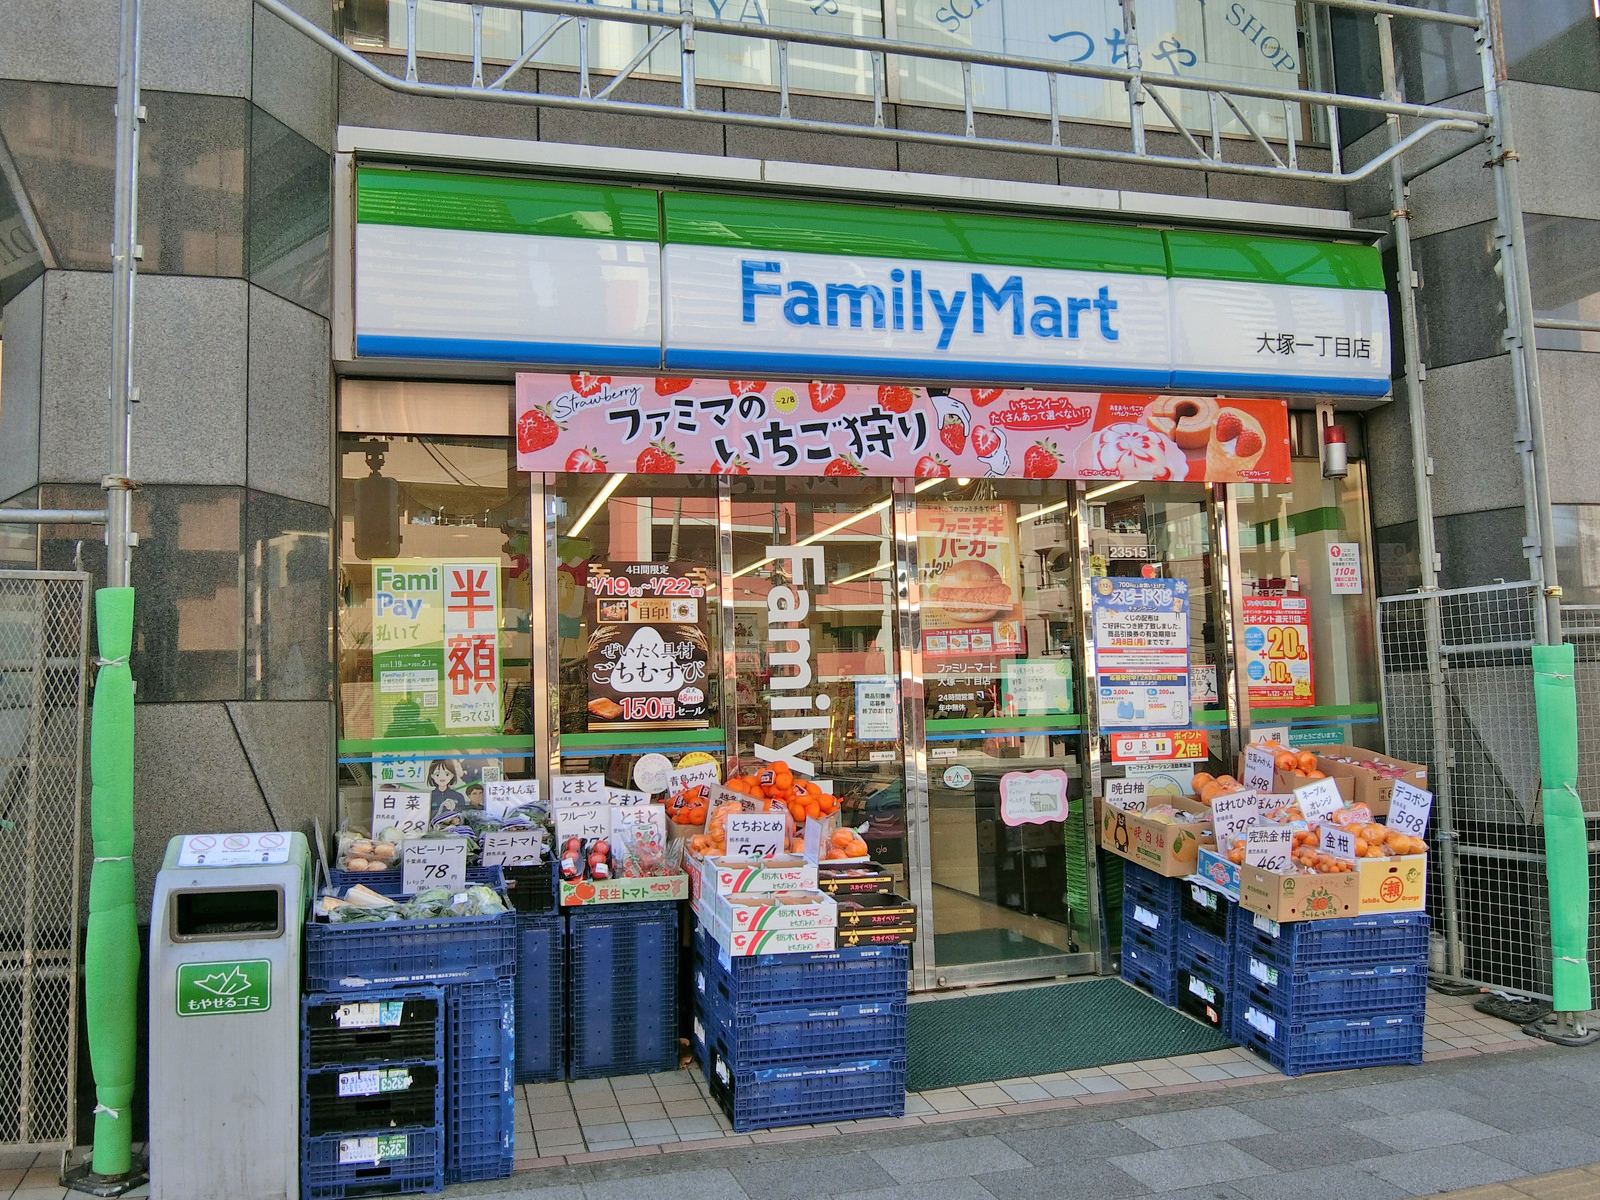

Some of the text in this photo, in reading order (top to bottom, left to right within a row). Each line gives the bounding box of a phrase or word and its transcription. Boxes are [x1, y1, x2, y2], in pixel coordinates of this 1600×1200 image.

[1225, 2, 1296, 73] SHOP
[741, 260, 1119, 350] FamilyMart
[1256, 332, 1372, 358] 大塚一丁目店
[554, 384, 643, 419] Strawberry
[609, 394, 767, 442] ファミマの
[714, 407, 928, 468] いちご狩り
[929, 516, 1004, 538] ファミチキ
[938, 538, 998, 559] バーガー
[1109, 547, 1147, 558] 23515
[625, 564, 670, 576] 4日間限定
[376, 567, 438, 591] Fami
[1110, 589, 1172, 606] スピードくじ
[376, 593, 423, 620] Pay
[639, 607, 670, 620] 目印!
[376, 623, 421, 642] 払いで
[447, 568, 497, 695] 半額
[1102, 622, 1182, 630] ご好評につき終了致しました。
[601, 641, 695, 660] ぜいたく具材
[592, 660, 706, 685] ごちむすび
[937, 663, 998, 673] ファミリーマート
[937, 677, 992, 687] 大塚一丁目店
[938, 693, 975, 702] 24時間営業
[619, 697, 676, 720] 150円
[675, 706, 706, 717] セール
[938, 704, 967, 712] 年中無休
[450, 710, 496, 723] 戻ってくる!
[1174, 731, 1202, 740] ポイント
[1258, 731, 1282, 743] 八朔
[1174, 739, 1203, 759] 2倍!
[1247, 751, 1274, 769] 甘夏みかん
[381, 767, 422, 781] 働こう!
[488, 784, 537, 796] ほうれん草
[562, 779, 599, 795] とまと
[1111, 782, 1145, 796] 晩白柚
[1250, 775, 1270, 792] 498
[1302, 785, 1327, 800] ネーブル
[1395, 785, 1429, 808] デコポン
[383, 795, 421, 811] 白菜
[1215, 794, 1257, 813] はれひめ
[1310, 795, 1332, 810] オレンジ
[560, 810, 597, 822] フルーツ
[621, 809, 658, 826] とまと
[1395, 810, 1424, 833] 598
[582, 823, 606, 835] トマト
[732, 820, 784, 833] とちおとめ
[488, 836, 538, 848] ミニトマト
[1248, 829, 1292, 843] 完熟金柑
[1324, 831, 1349, 853] 金柑
[405, 845, 465, 856] ベビーリーフ
[875, 845, 888, 856] glo
[1257, 855, 1286, 871] 462
[424, 864, 450, 879] 78
[761, 871, 802, 880] 栃木いちご
[597, 887, 650, 900] 長生トマト
[778, 908, 820, 918] 栃木いちご
[775, 932, 818, 942] 栃木いちご
[187, 995, 260, 1010] もやせるゴミ
